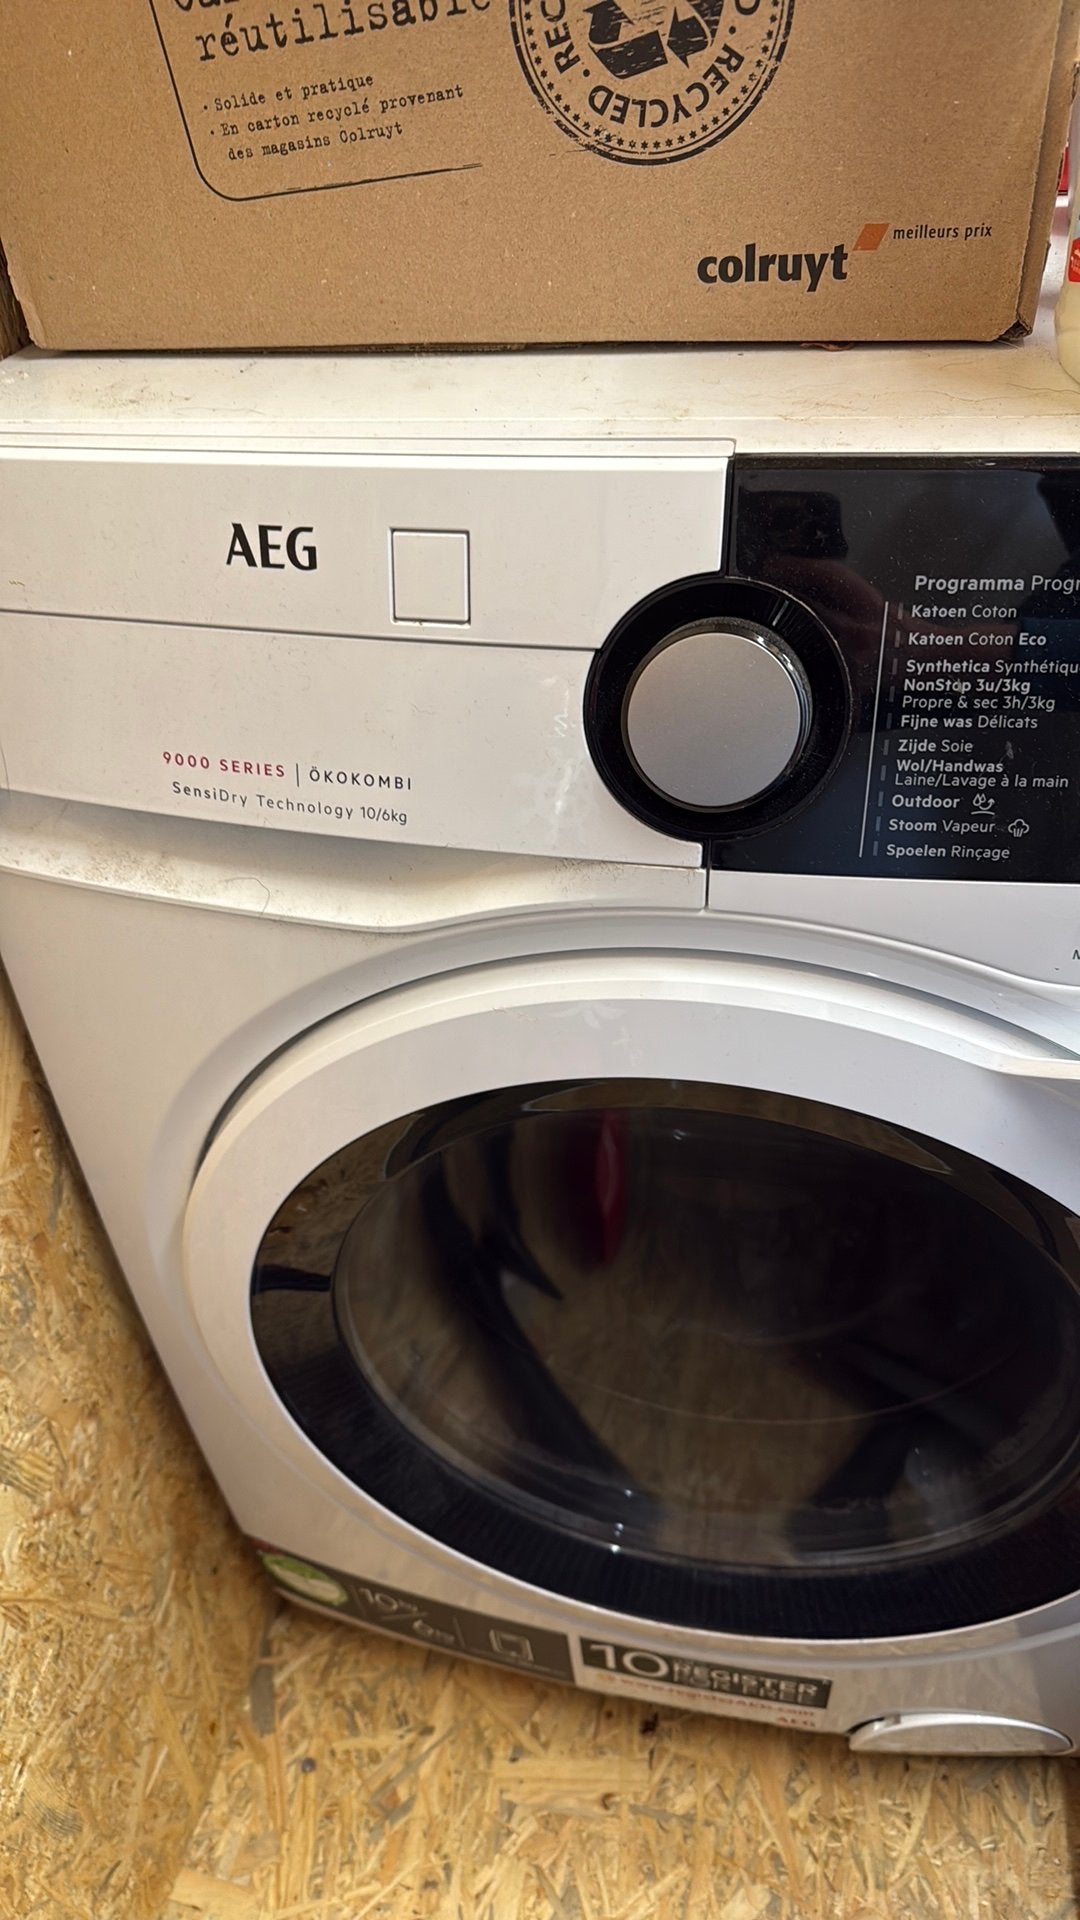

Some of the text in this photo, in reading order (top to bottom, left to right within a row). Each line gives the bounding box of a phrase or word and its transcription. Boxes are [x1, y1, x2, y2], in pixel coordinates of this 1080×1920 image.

[214, 74, 374, 112] Solide et pratique
[587, 43, 745, 128] RECYCLED
[219, 85, 464, 138] En carton recyclé provenant
[228, 121, 403, 161] des magasins Colruyt
[892, 223, 993, 241] meilleurs prix
[697, 243, 848, 293] colruyt
[226, 522, 318, 571] AEG
[914, 575, 1025, 595] Programma
[911, 604, 1018, 618] Katoen Coton
[908, 632, 1047, 646] Katoen Coton Eco
[906, 659, 1080, 677] Synthetica Synthétiqu
[903, 678, 1031, 694] NonStop 3u/3kg
[901, 695, 1056, 712] Propre & sec 3h/3kg
[900, 714, 1039, 730] Fijne was Délicats
[898, 738, 974, 754] Zijde Soie
[162, 751, 412, 791] 9000 SERIES ÖKOKOMBI
[896, 758, 1004, 773] Wol/Handwas
[894, 773, 1069, 790] Laine/Lavage à la main
[171, 781, 408, 826] SensiDry Technology 10/6kg
[891, 794, 961, 809] Outdoor
[888, 818, 996, 835] Stoom Vapeur
[886, 843, 1010, 861] Spoelen Rinçage
[589, 1643, 671, 1679] 10
